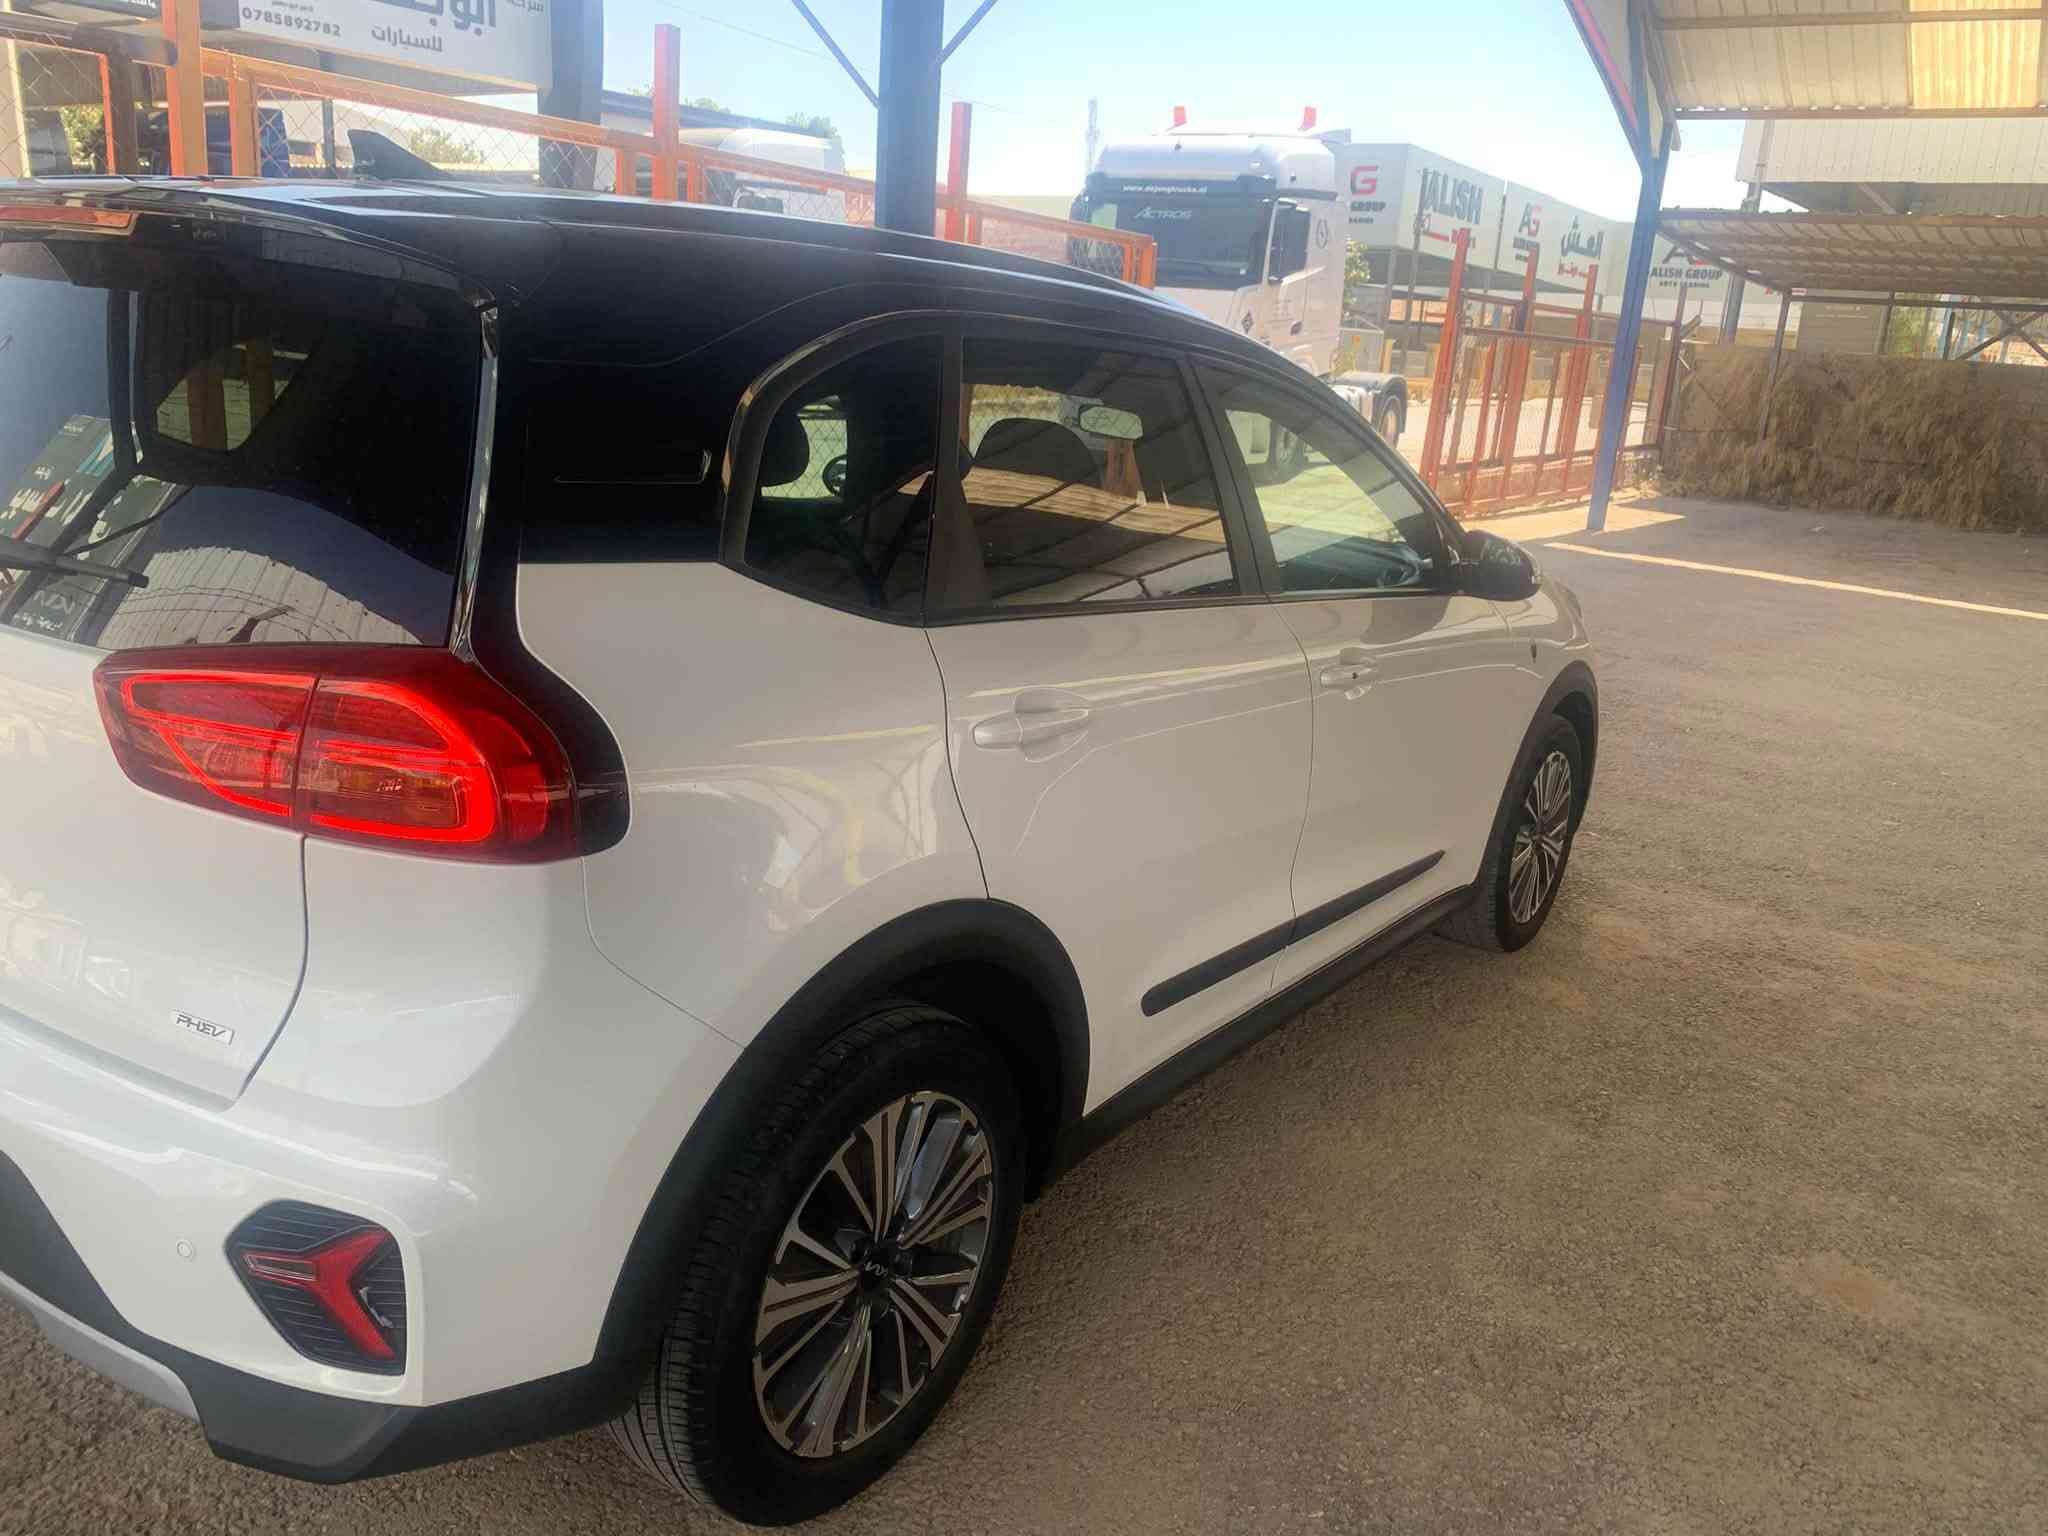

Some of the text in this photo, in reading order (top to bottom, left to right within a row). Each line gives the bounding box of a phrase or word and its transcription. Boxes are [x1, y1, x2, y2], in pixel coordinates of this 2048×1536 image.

[242, 7, 342, 37] 0785892782
[371, 24, 443, 53] للسيارات
[1651, 267, 1722, 280] ALISH GROUP
[176, 1014, 226, 1037] PHEV
